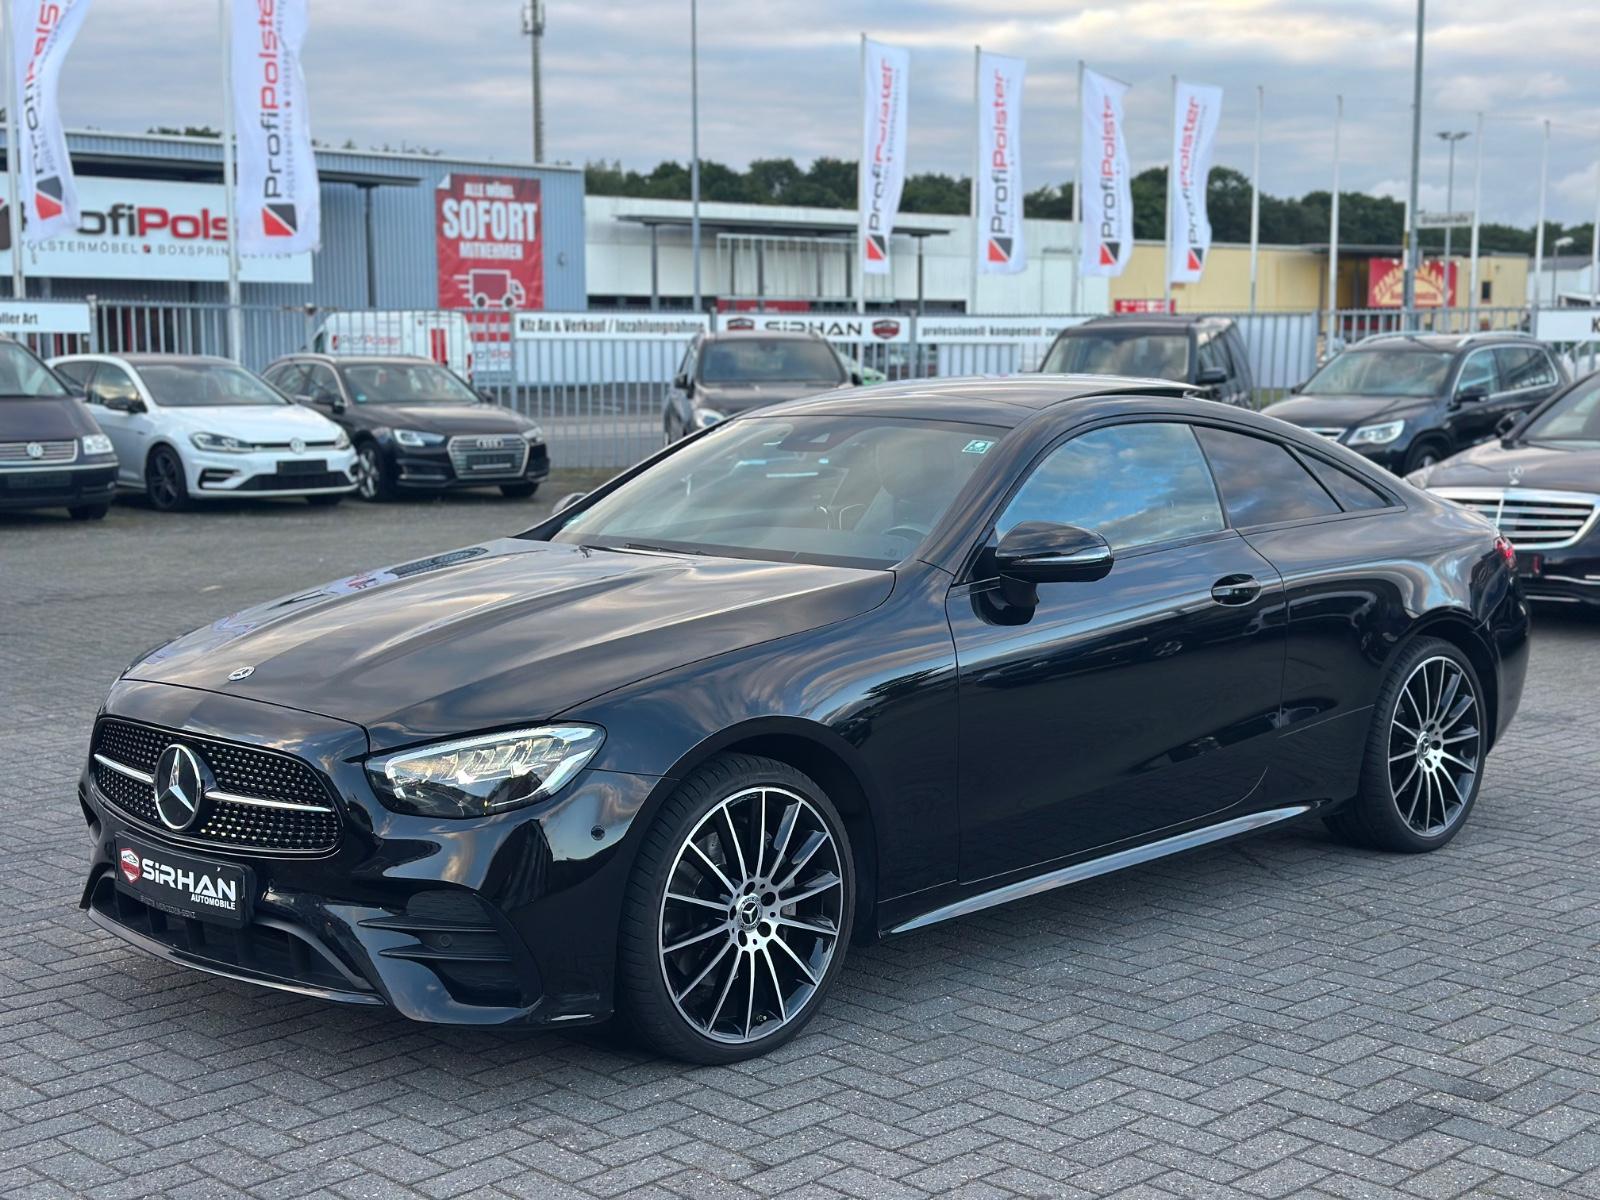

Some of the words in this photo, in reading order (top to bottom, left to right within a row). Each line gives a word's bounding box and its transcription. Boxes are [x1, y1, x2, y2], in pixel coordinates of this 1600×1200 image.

[991, 69, 1008, 233] ProfiPolster
[442, 198, 537, 242] SOFORT
[23, 311, 39, 325] Art
[520, 318, 537, 333] Kfz
[538, 318, 551, 333] An
[563, 318, 607, 333] Verkauf
[615, 319, 705, 335] Inzahlungnahme
[922, 325, 987, 338] professionell
[989, 325, 1042, 338] kompetent
[190, 893, 236, 911] AUTOMOBILE
